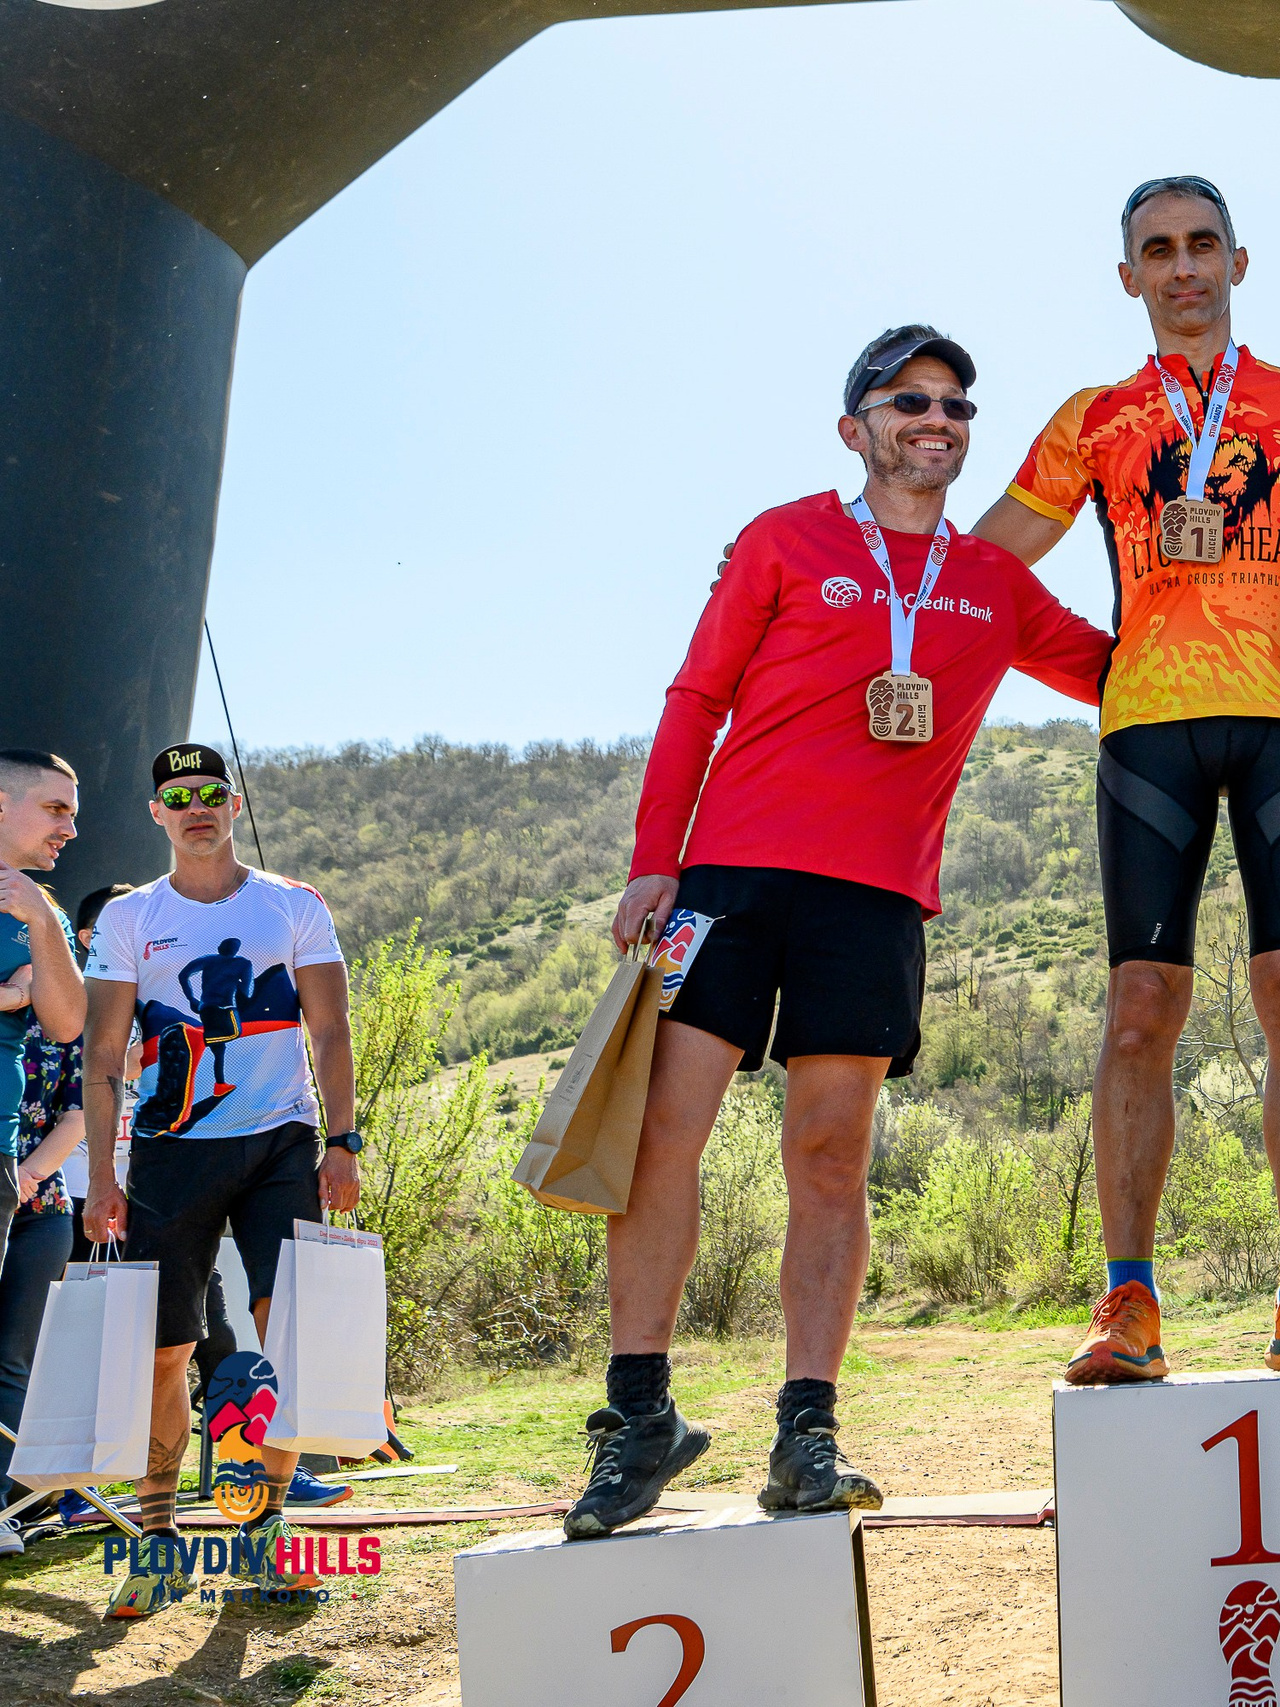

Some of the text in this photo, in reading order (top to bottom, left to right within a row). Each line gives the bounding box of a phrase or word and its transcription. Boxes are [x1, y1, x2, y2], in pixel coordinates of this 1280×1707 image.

[1189, 515, 1211, 524] HILLS
[1190, 507, 1221, 517] PLOVDIV
[1190, 526, 1204, 558] 1
[1149, 578, 1181, 596] ULTRA
[1187, 572, 1225, 585] CROSS
[959, 598, 994, 623] Bank
[896, 682, 929, 691] PLOVDIV
[896, 691, 920, 700] HILLS
[895, 703, 916, 736] 2
[610, 1613, 706, 1707] 2
